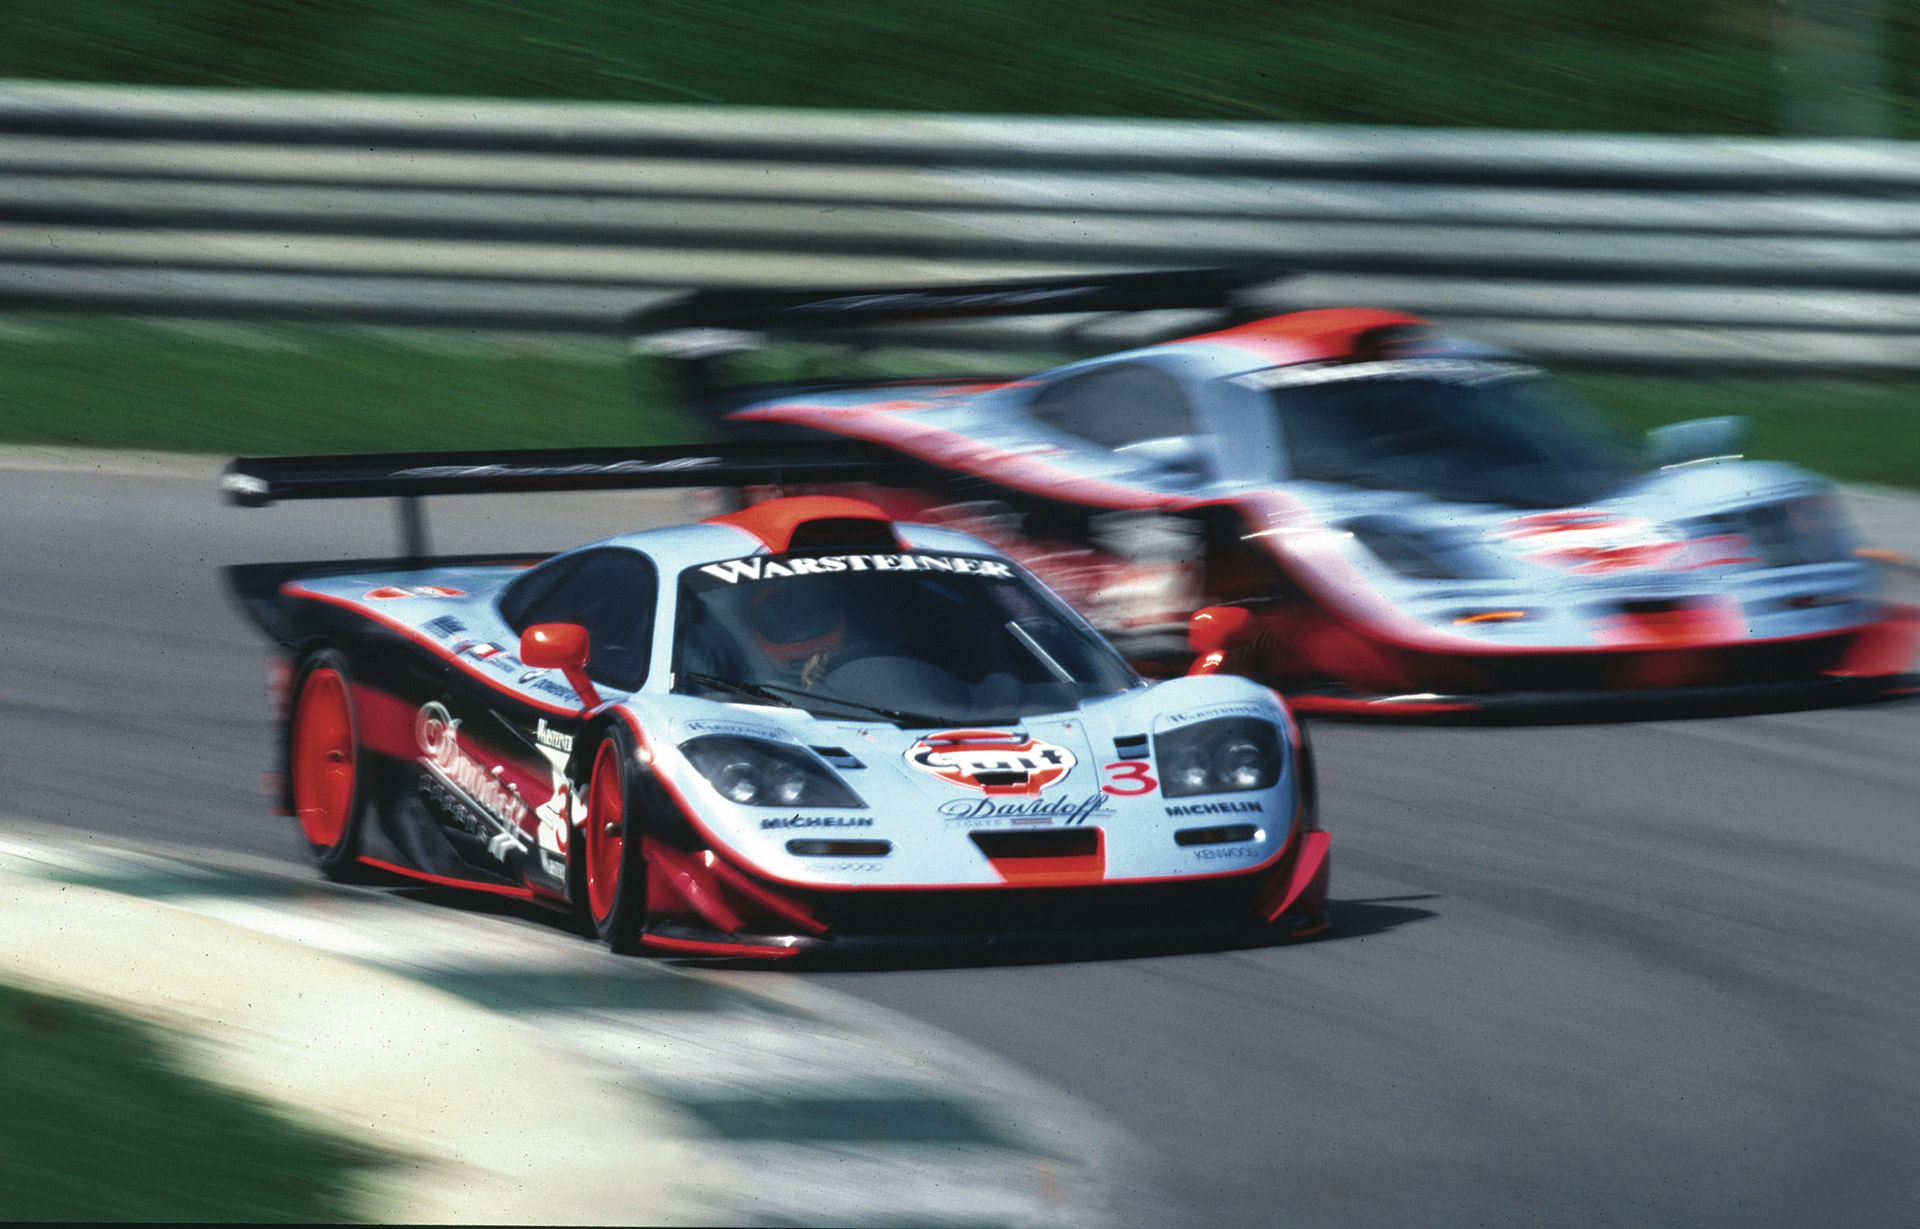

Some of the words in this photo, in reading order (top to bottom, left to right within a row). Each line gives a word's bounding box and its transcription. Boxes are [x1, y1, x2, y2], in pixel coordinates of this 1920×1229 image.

[701, 555, 1017, 584] WARSTEINER
[1102, 761, 1158, 796] 3
[939, 795, 1111, 825] Davidoff
[1165, 801, 1264, 817] MICHELIN
[761, 816, 874, 829] MICHELIN
[1194, 847, 1259, 859] KENWOOD
